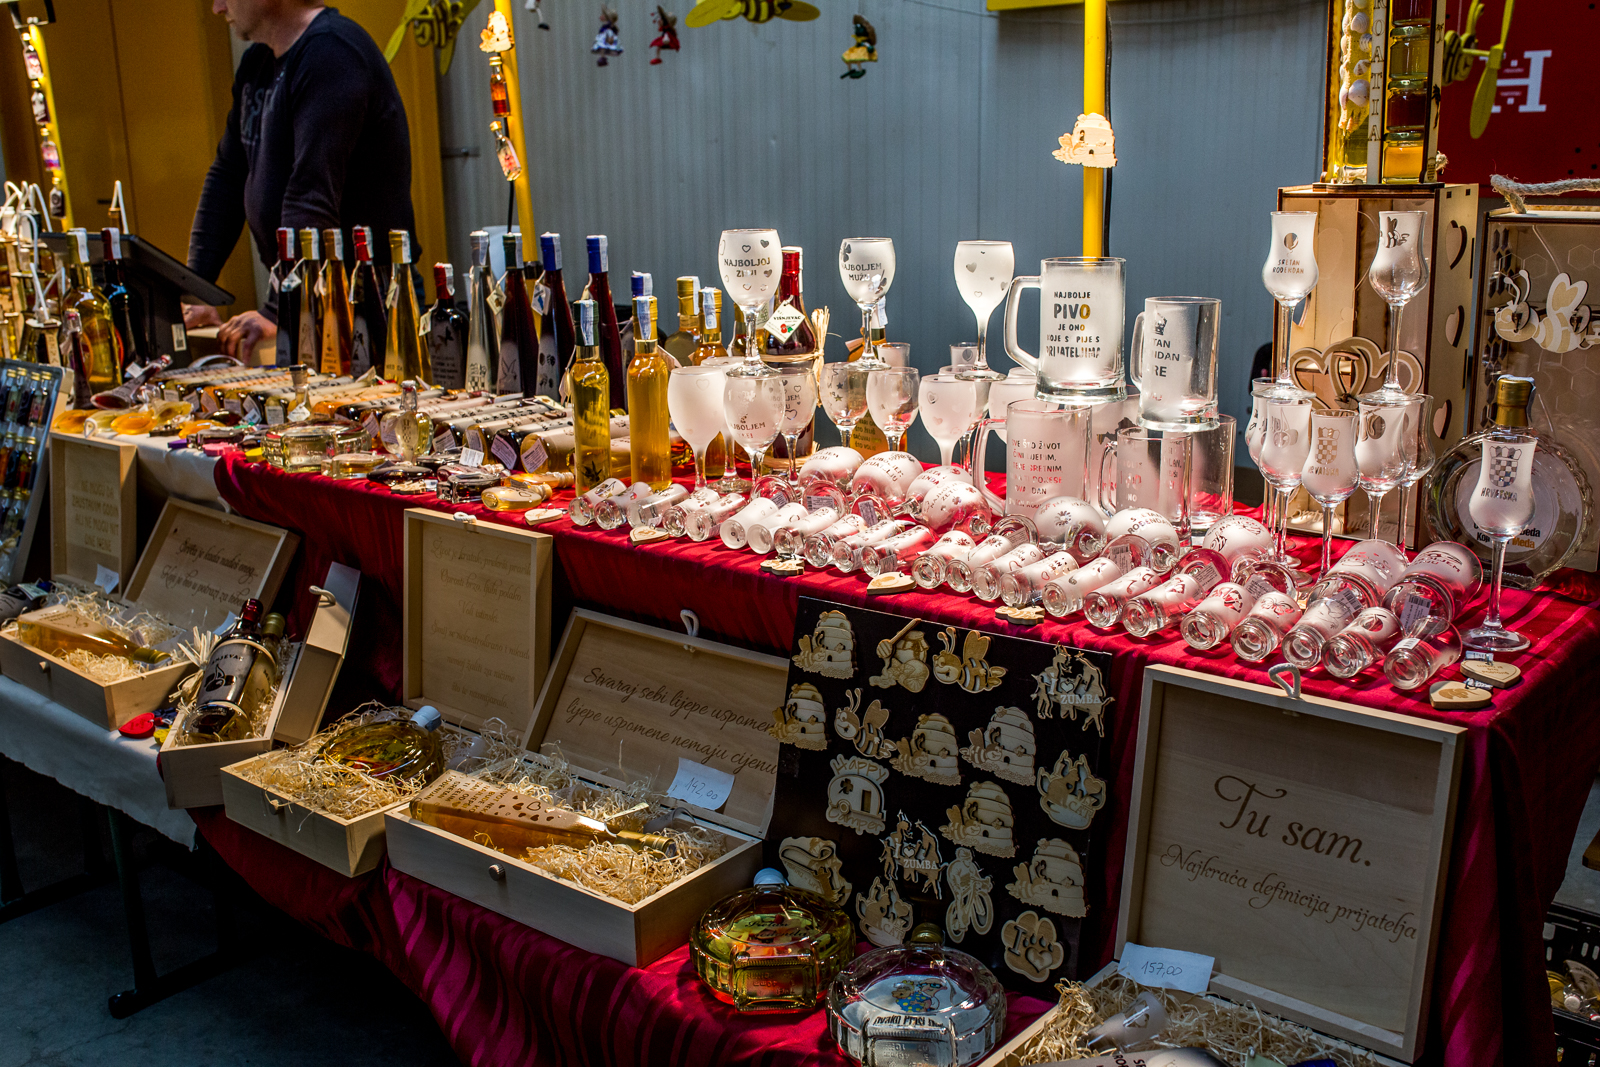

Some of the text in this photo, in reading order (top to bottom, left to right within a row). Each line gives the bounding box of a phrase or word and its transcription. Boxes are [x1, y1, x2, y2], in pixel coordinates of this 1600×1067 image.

[724, 257, 771, 267] NAJBOLJOJ
[1054, 291, 1091, 299] NAJBOLJE
[1054, 303, 1091, 320] PIVO
[1076, 335, 1093, 343] PIJE
[1032, 487, 1047, 495] DAN
[1480, 487, 1518, 502] HRVATSKA
[583, 667, 639, 703] Stvaraj
[638, 685, 669, 705] sebi
[668, 690, 709, 720] lijepe
[1060, 694, 1102, 705] ZUMBA
[565, 697, 778, 775] lijepe uspomene nemaju cijenu
[832, 760, 887, 781] Happy
[1213, 775, 1371, 867] Tu sam.
[903, 859, 938, 870] ZUMBA
[1160, 844, 1417, 943] Najkraća definicija prijatelja
[1008, 925, 1026, 956] I
[1141, 961, 1183, 978] 157,00
